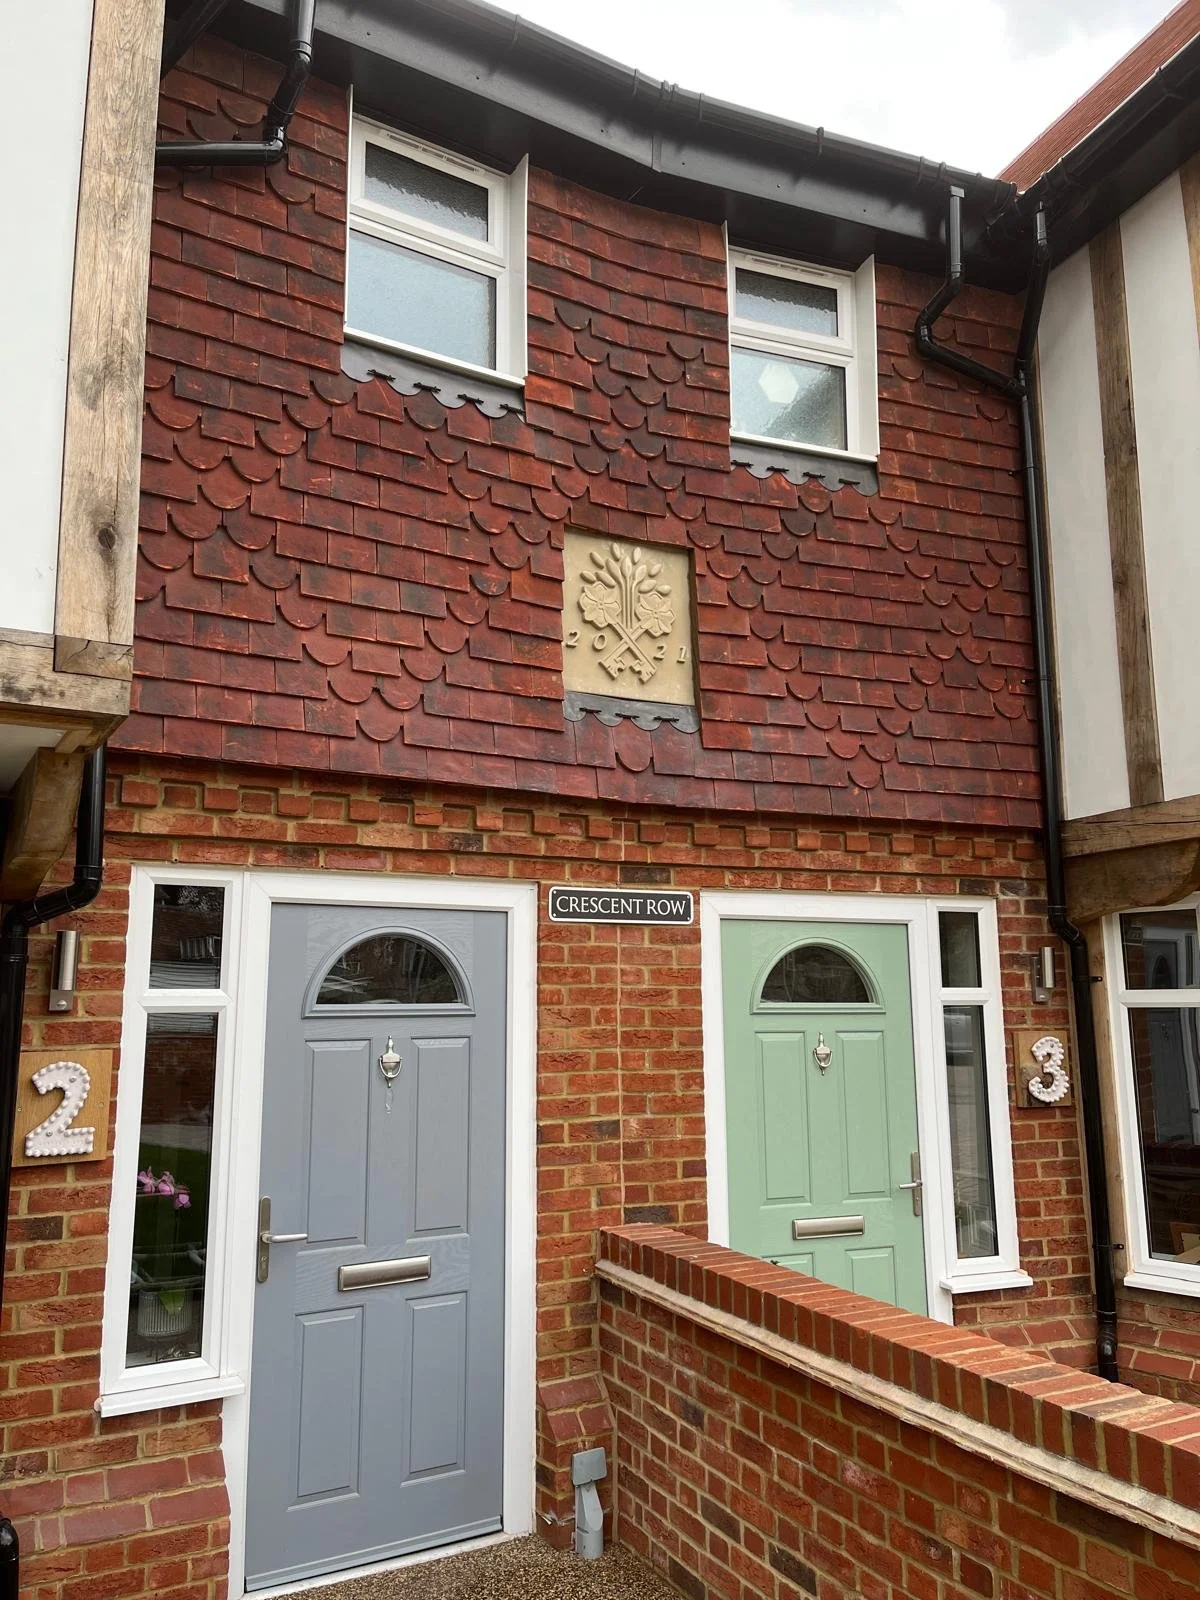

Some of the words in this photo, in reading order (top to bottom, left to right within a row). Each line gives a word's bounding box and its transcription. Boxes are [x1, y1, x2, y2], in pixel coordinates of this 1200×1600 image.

[556, 895, 643, 915] CRESCENT
[647, 899, 686, 916] ROW
[1028, 1036, 1069, 1102] 3
[24, 1061, 96, 1157] 2
